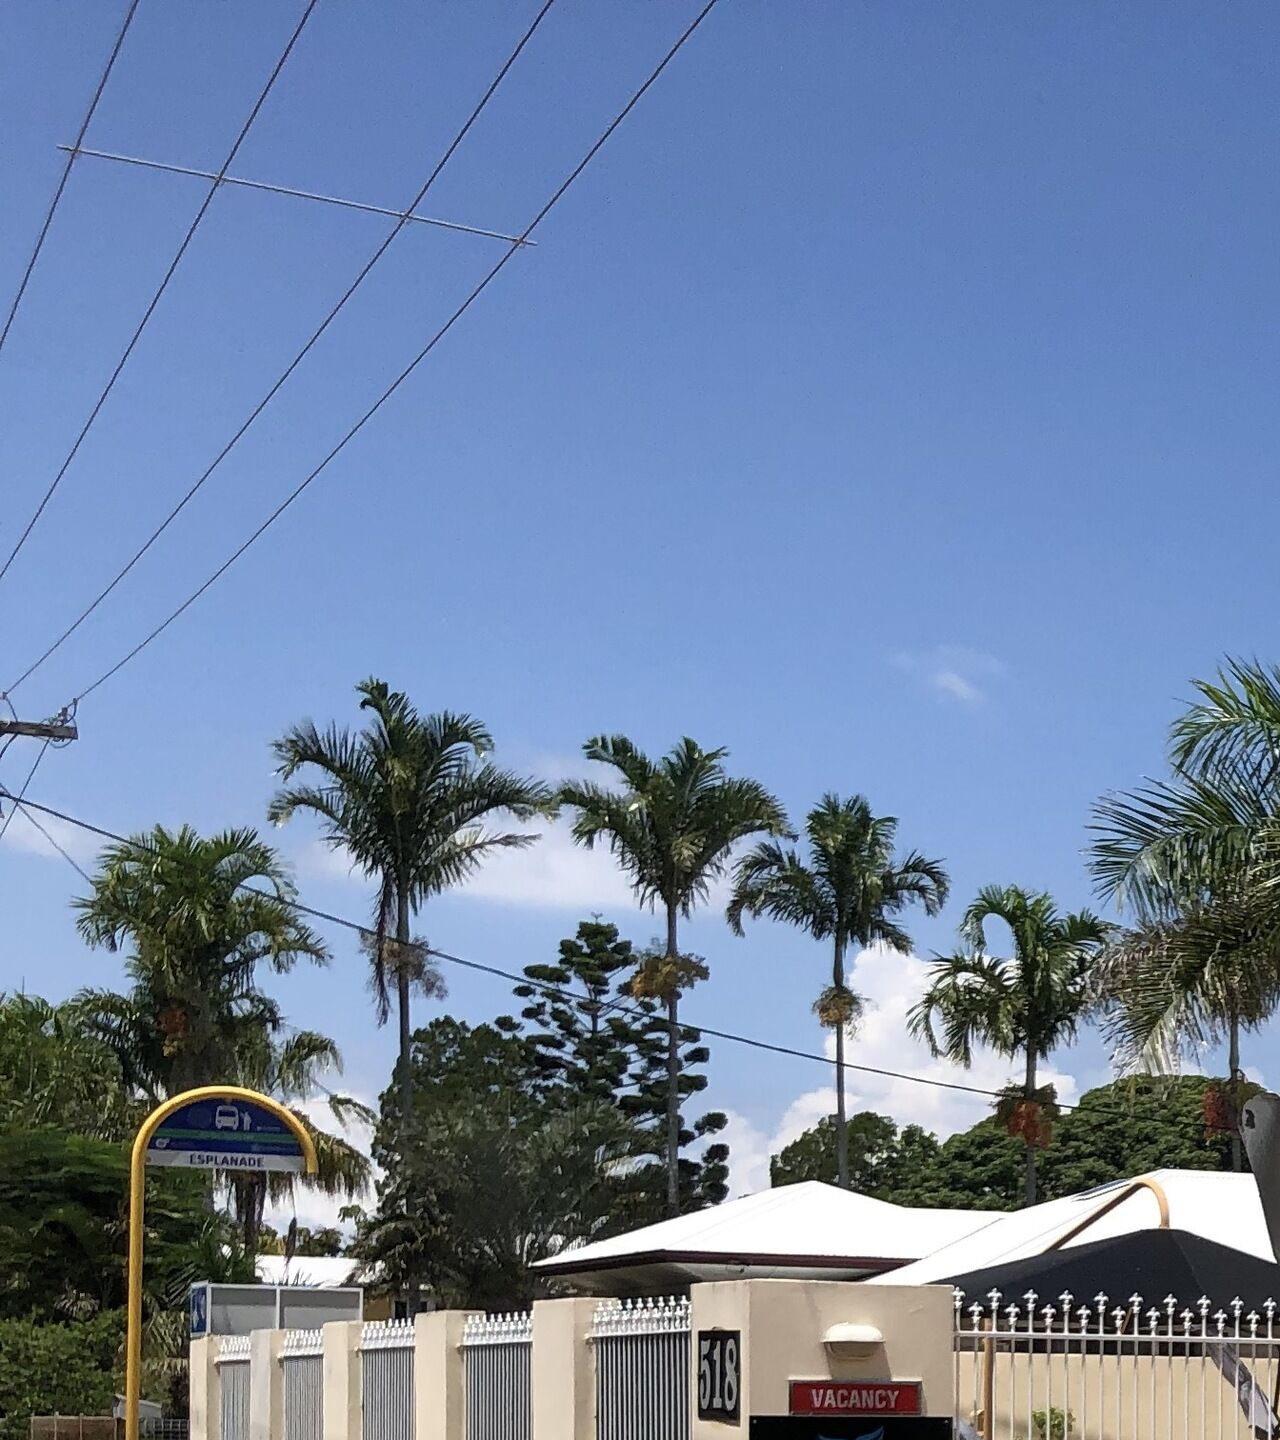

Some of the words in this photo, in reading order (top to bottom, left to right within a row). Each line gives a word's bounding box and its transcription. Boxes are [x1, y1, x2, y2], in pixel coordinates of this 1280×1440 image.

[189, 1153, 265, 1168] ESPLANADE
[700, 1338, 738, 1412] 518
[811, 1387, 900, 1410] VACANCY
